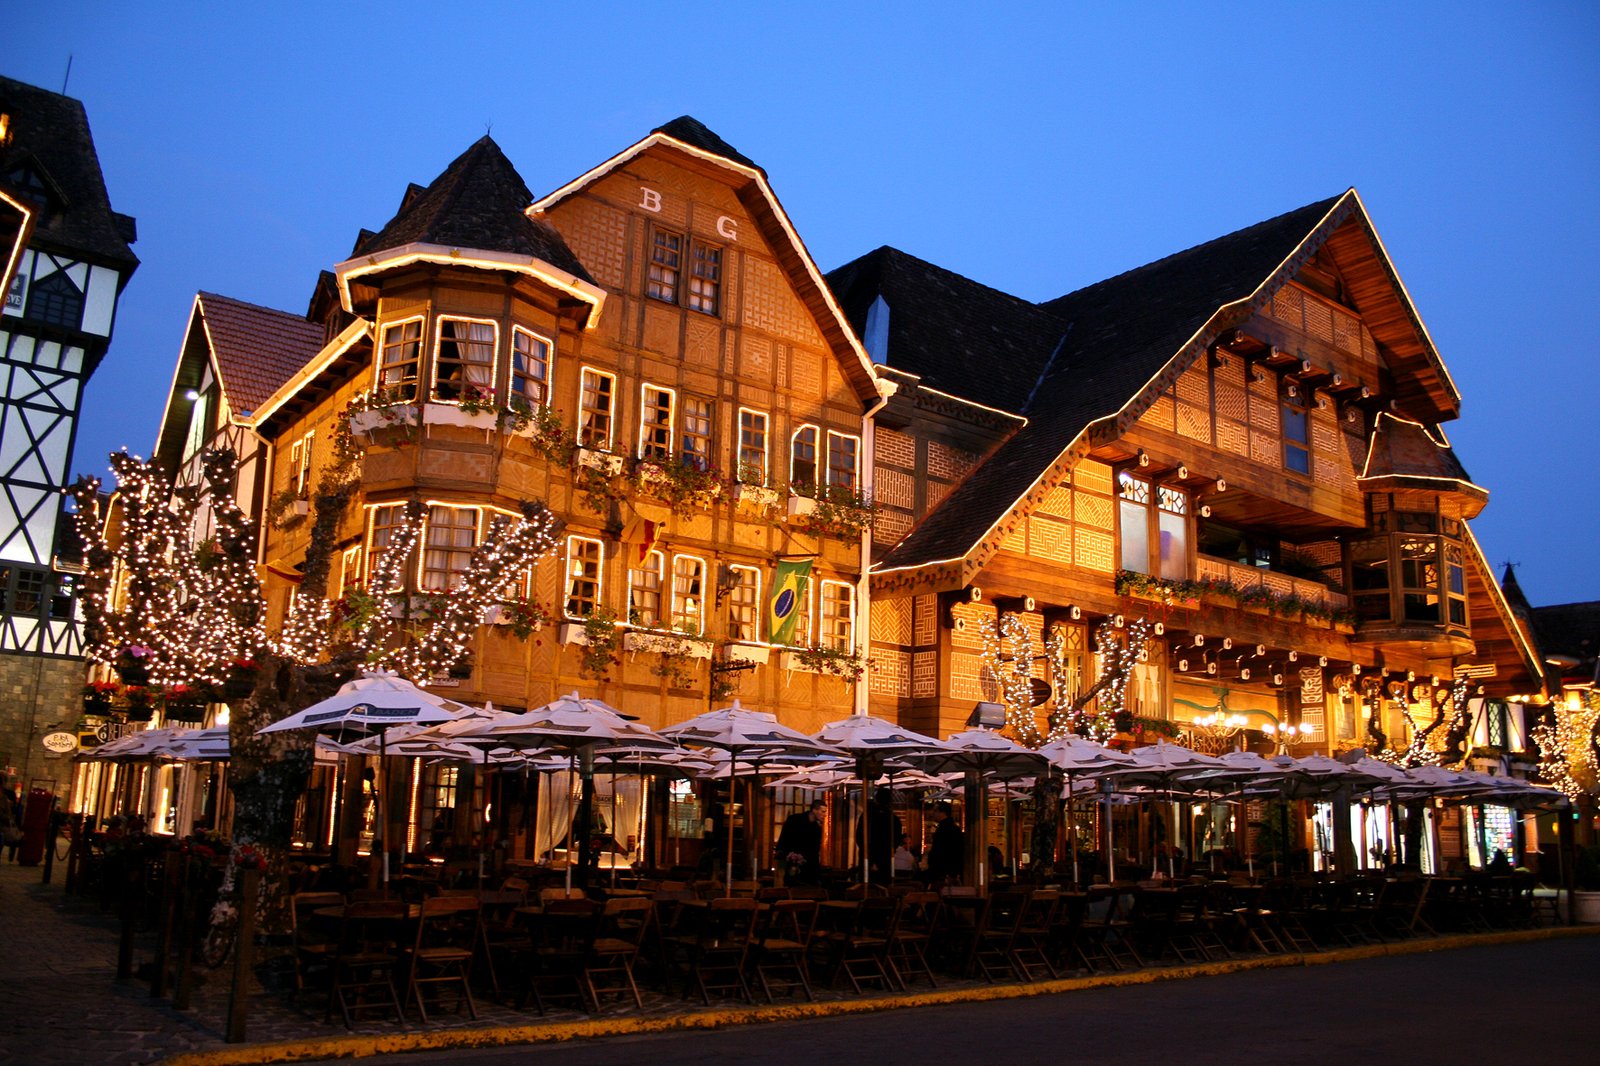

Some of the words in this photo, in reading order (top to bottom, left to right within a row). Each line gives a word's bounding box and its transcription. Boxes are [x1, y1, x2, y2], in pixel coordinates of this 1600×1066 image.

[638, 186, 662, 213] B
[716, 215, 738, 241] G
[374, 708, 416, 716] BADEN
